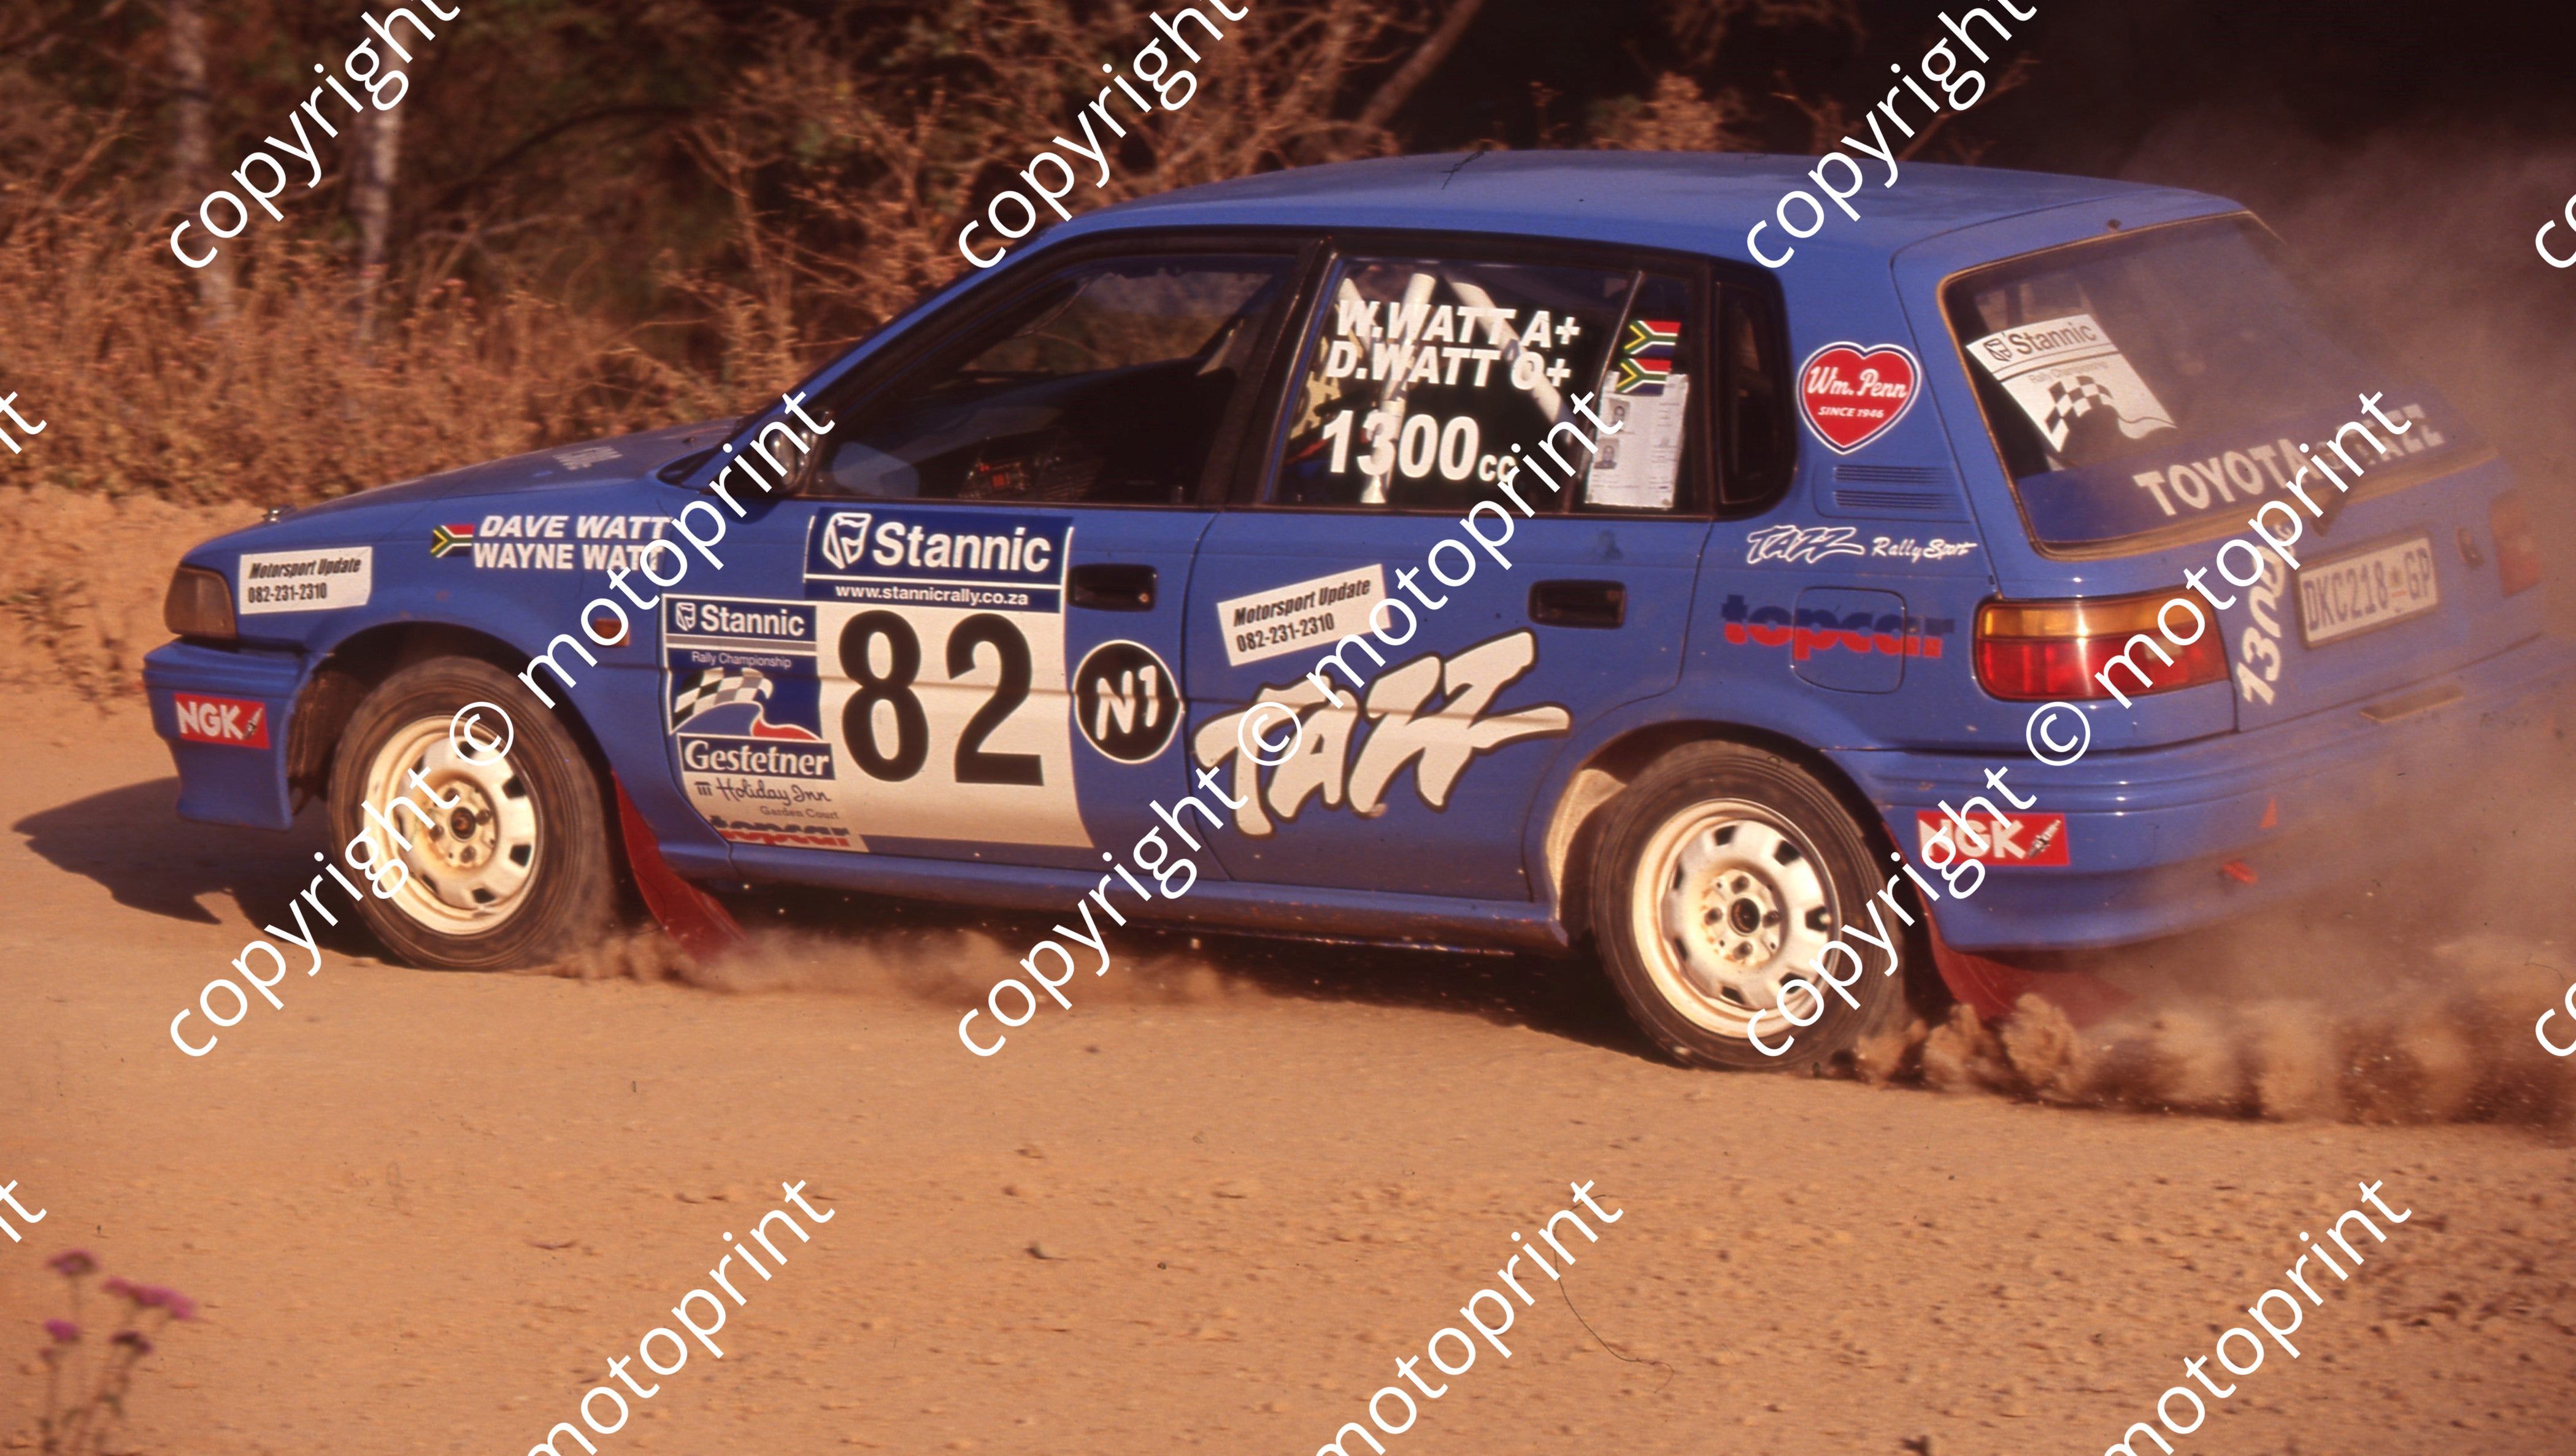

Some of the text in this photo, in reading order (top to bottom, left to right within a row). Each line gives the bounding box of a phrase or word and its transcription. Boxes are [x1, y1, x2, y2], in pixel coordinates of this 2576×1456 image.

[2007, 322, 2097, 355] Stannic
[1858, 368, 1908, 398] Penn
[1818, 406, 1885, 419] SINCE 1946
[2132, 438, 2324, 517] TOYOTA
[479, 515, 672, 539] DAVE WATT
[473, 543, 665, 571] WAYNE WATT
[872, 522, 1052, 573] Stannic
[1872, 536, 1923, 564] Rally
[248, 557, 361, 580] Motorsport Update
[2404, 546, 2431, 600] GP
[247, 583, 328, 604] 082-231-2310
[835, 584, 1029, 606] www.stannicrally.co.za
[1232, 578, 1372, 628] Motorsport Update
[701, 604, 805, 637] Stannic
[1236, 612, 1336, 653] 082-231-2310
[1721, 594, 1956, 661] topcar
[691, 651, 793, 669] Rally Championship
[838, 610, 1045, 788] 82
[1095, 664, 1158, 742] N1
[175, 701, 247, 739] NGK
[684, 739, 831, 777] Gestetner
[717, 777, 832, 806] Holiday Inn
[759, 805, 840, 819] Garden Court
[709, 815, 850, 847] topcar
[1918, 818, 2026, 860] NGK
